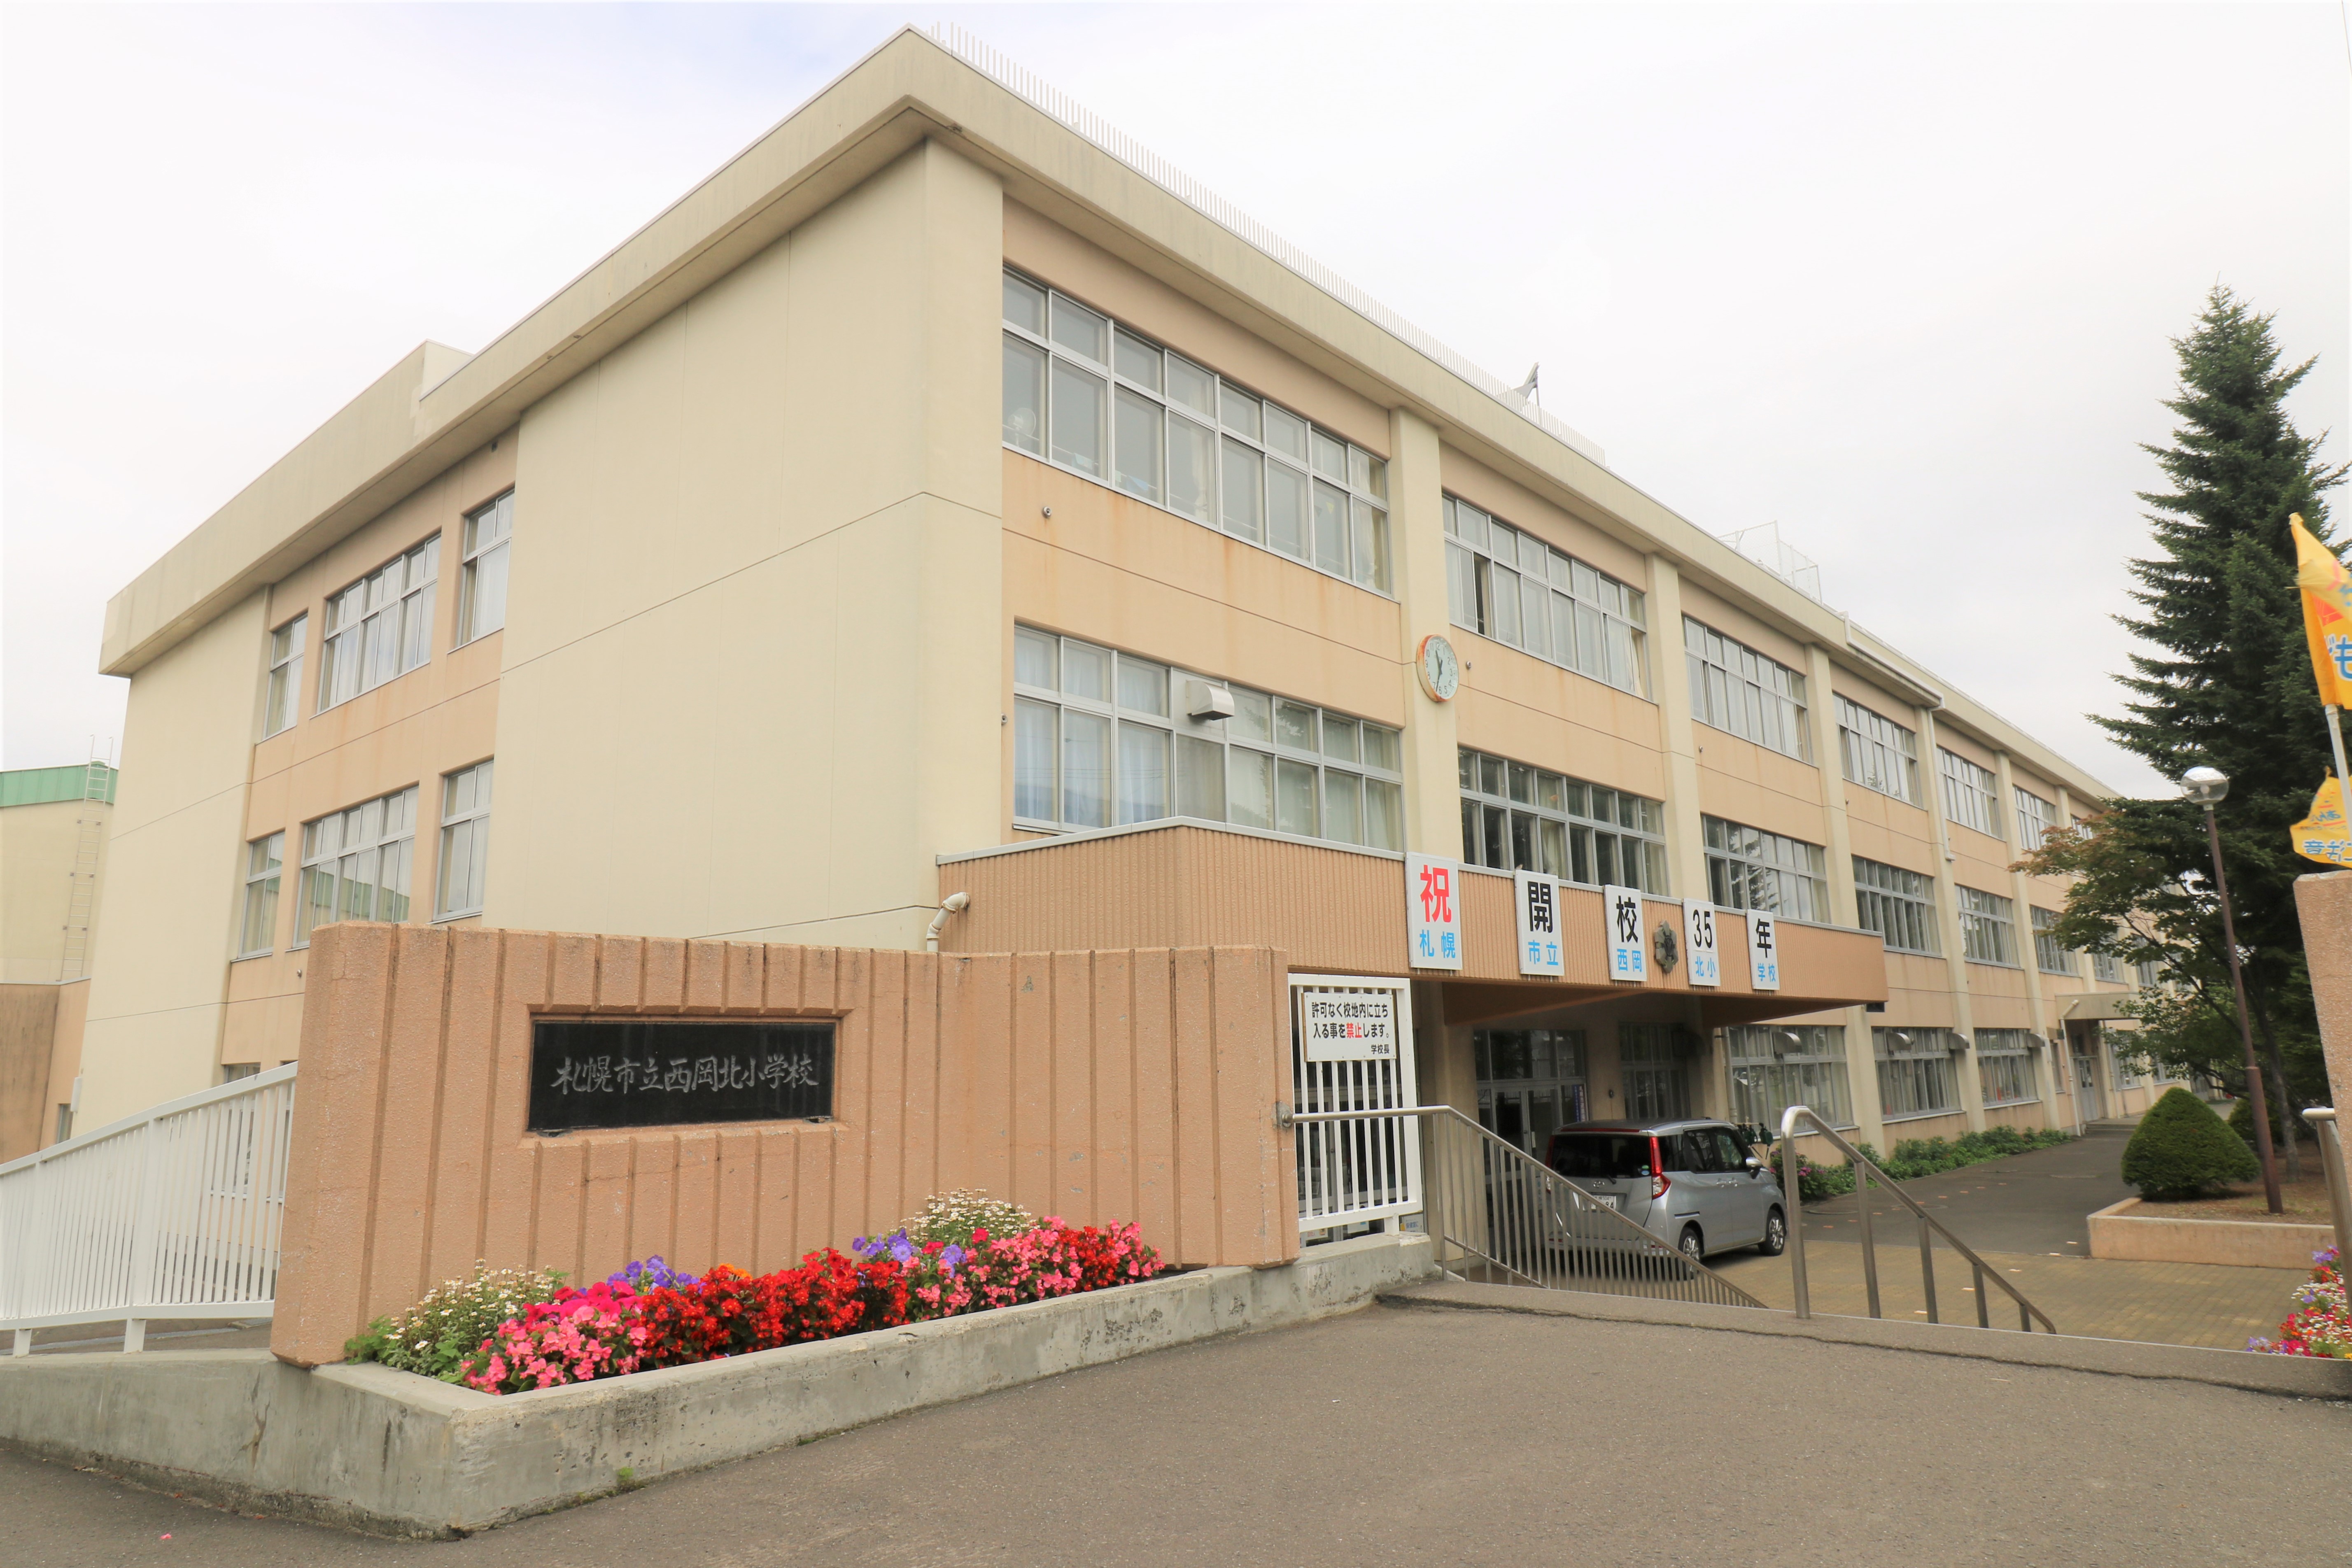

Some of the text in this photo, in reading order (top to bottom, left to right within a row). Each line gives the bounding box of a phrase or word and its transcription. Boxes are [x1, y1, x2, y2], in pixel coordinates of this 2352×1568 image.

[1420, 864, 1772, 958] 祝 開 校 35 年
[1420, 930, 1776, 982] 札幌 市立 西岡 北小 学校
[1312, 1002, 1388, 1018] 許可なく校地内に立ち
[1313, 1022, 1389, 1039] 入る事を禁止します。
[1371, 1044, 1389, 1054] 学校長
[551, 1053, 819, 1095] 札幌市立西岡北小学校
